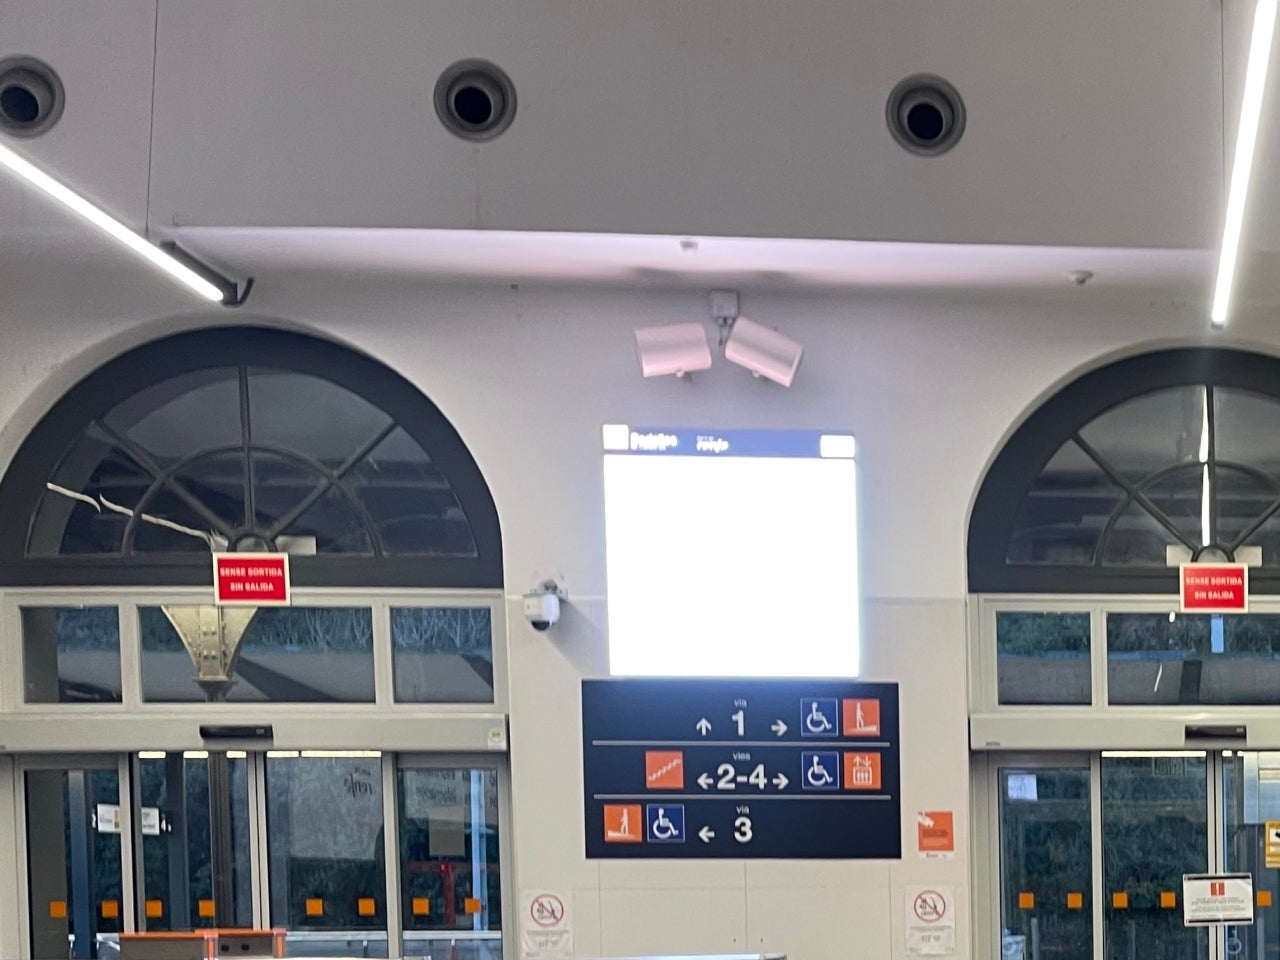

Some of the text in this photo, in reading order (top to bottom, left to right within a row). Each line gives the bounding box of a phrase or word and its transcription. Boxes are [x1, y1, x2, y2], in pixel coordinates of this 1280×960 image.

[245, 582, 274, 592] SALIDA
[1207, 590, 1234, 600] SALIDA
[734, 699, 747, 707] via
[732, 709, 745, 736] 1
[716, 762, 768, 790] 2-4
[736, 805, 750, 814] via
[733, 816, 753, 843] 3
